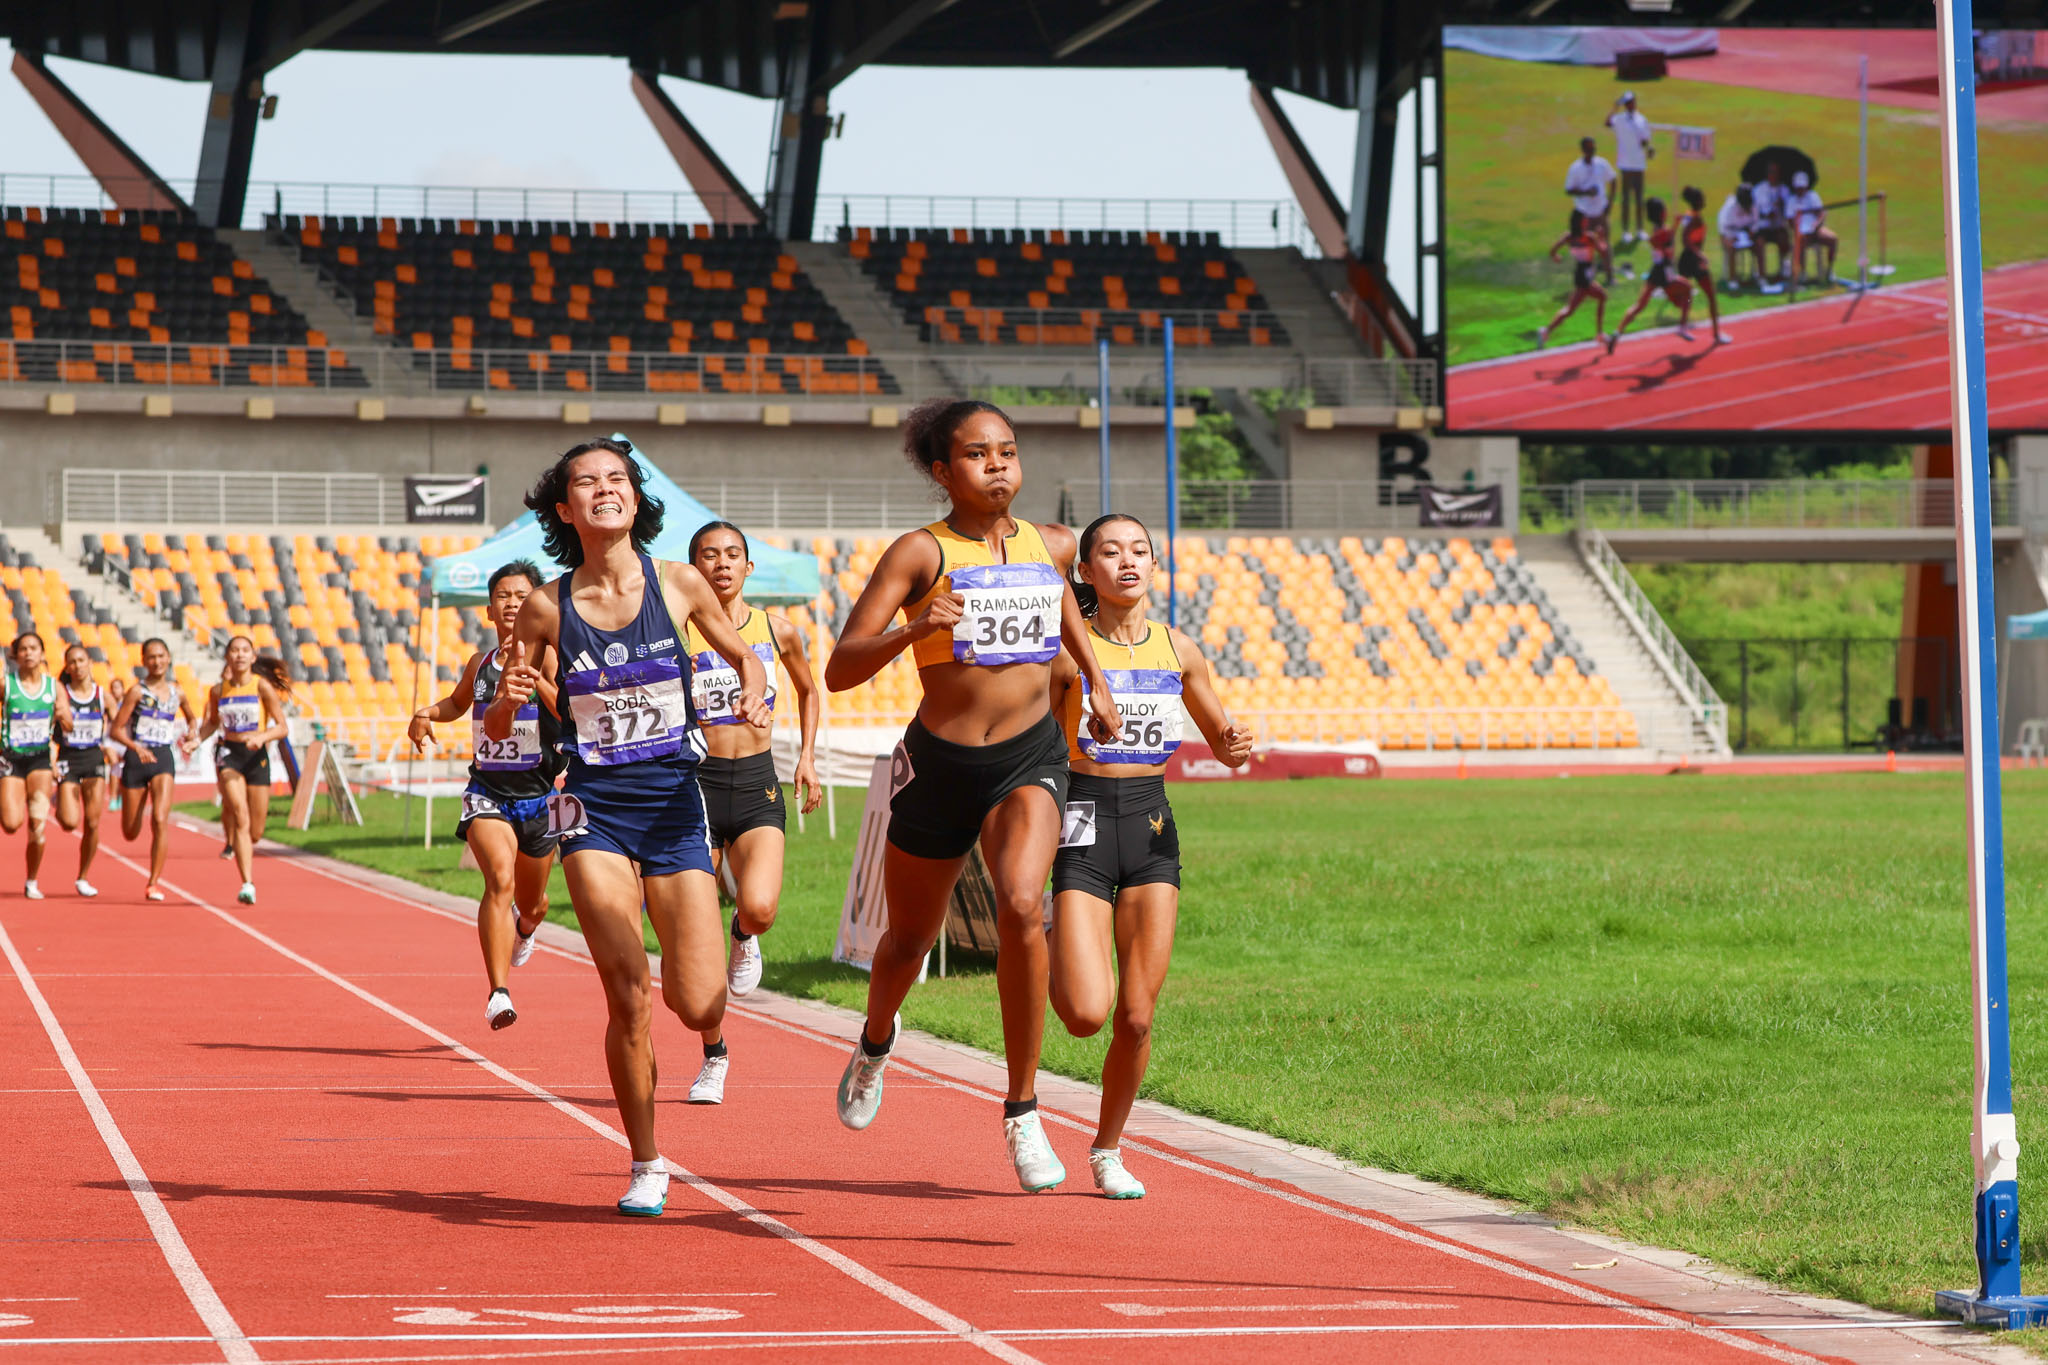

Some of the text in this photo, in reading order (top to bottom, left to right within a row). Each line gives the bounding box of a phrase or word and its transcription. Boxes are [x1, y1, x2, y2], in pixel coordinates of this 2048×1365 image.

[970, 596, 1052, 613] RAMADAN
[976, 615, 1043, 646] 364
[604, 694, 650, 712] RODA
[709, 687, 741, 711] 36
[1115, 703, 1158, 716] DILOY
[598, 708, 665, 745] 372
[1105, 720, 1163, 747] 56
[478, 741, 519, 760] 423
